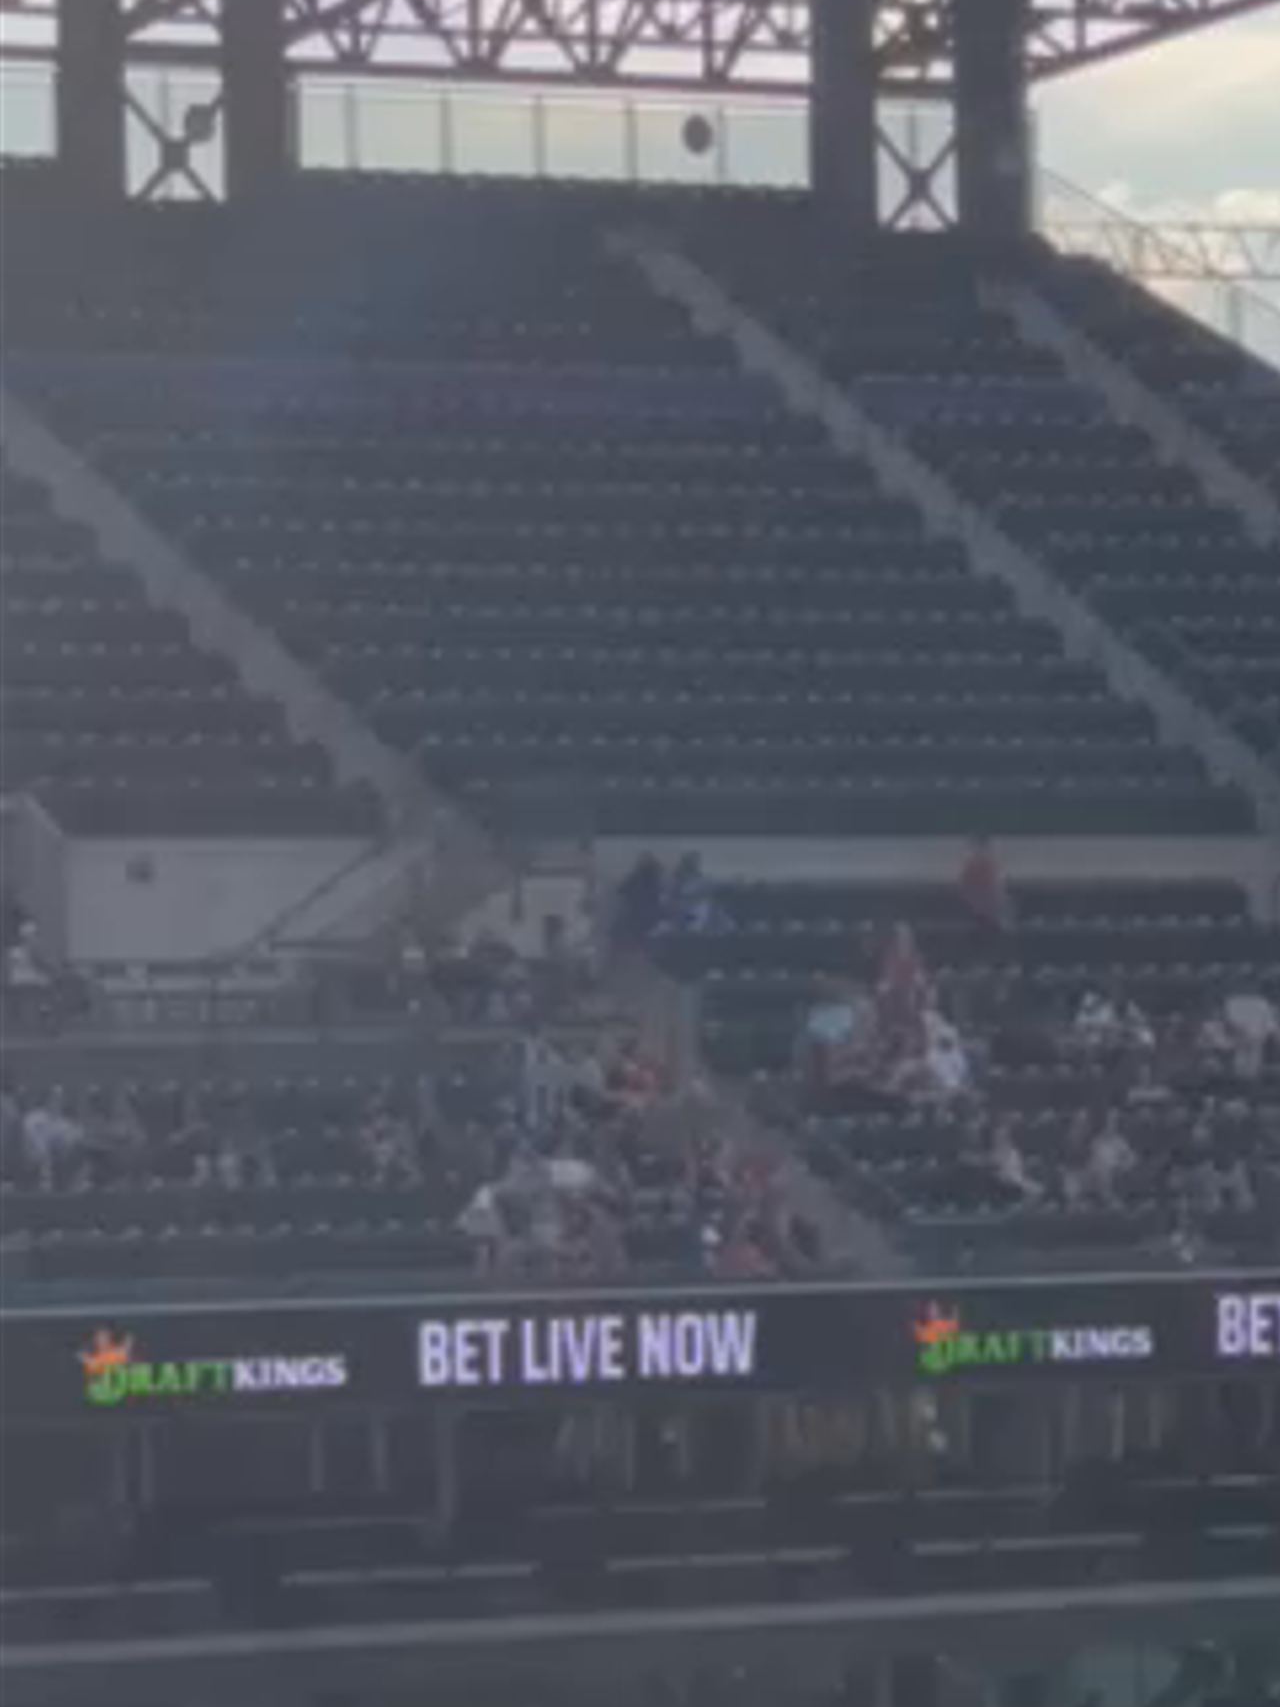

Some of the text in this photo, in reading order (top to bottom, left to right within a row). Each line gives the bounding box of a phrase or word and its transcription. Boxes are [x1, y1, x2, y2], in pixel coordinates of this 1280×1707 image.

[418, 1309, 758, 1386] BET LIVE NOW
